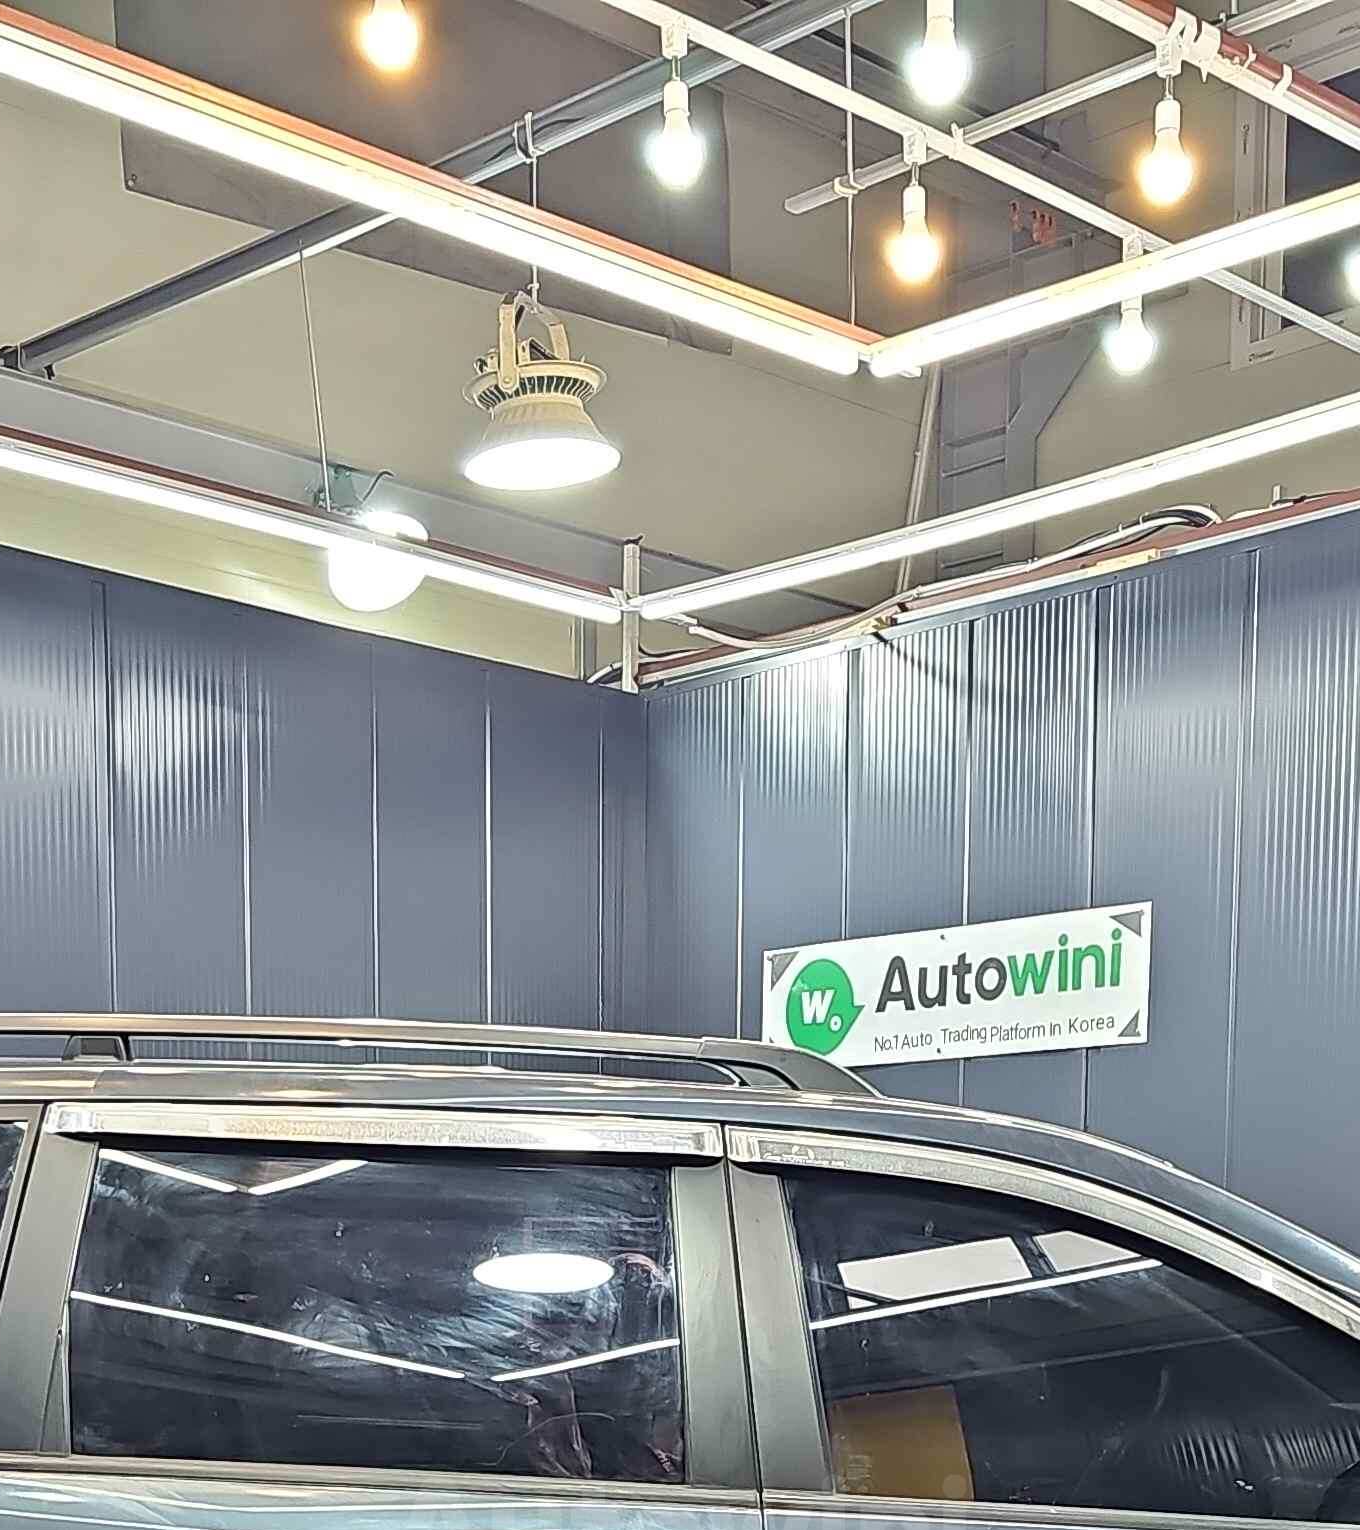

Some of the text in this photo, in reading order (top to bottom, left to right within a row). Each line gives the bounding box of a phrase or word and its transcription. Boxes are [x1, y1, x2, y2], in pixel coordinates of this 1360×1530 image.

[875, 928, 1122, 1013] Autowini
[940, 1024, 987, 1044] Trading
[990, 1021, 1046, 1042] Platform
[1068, 1016, 1116, 1034] Korea
